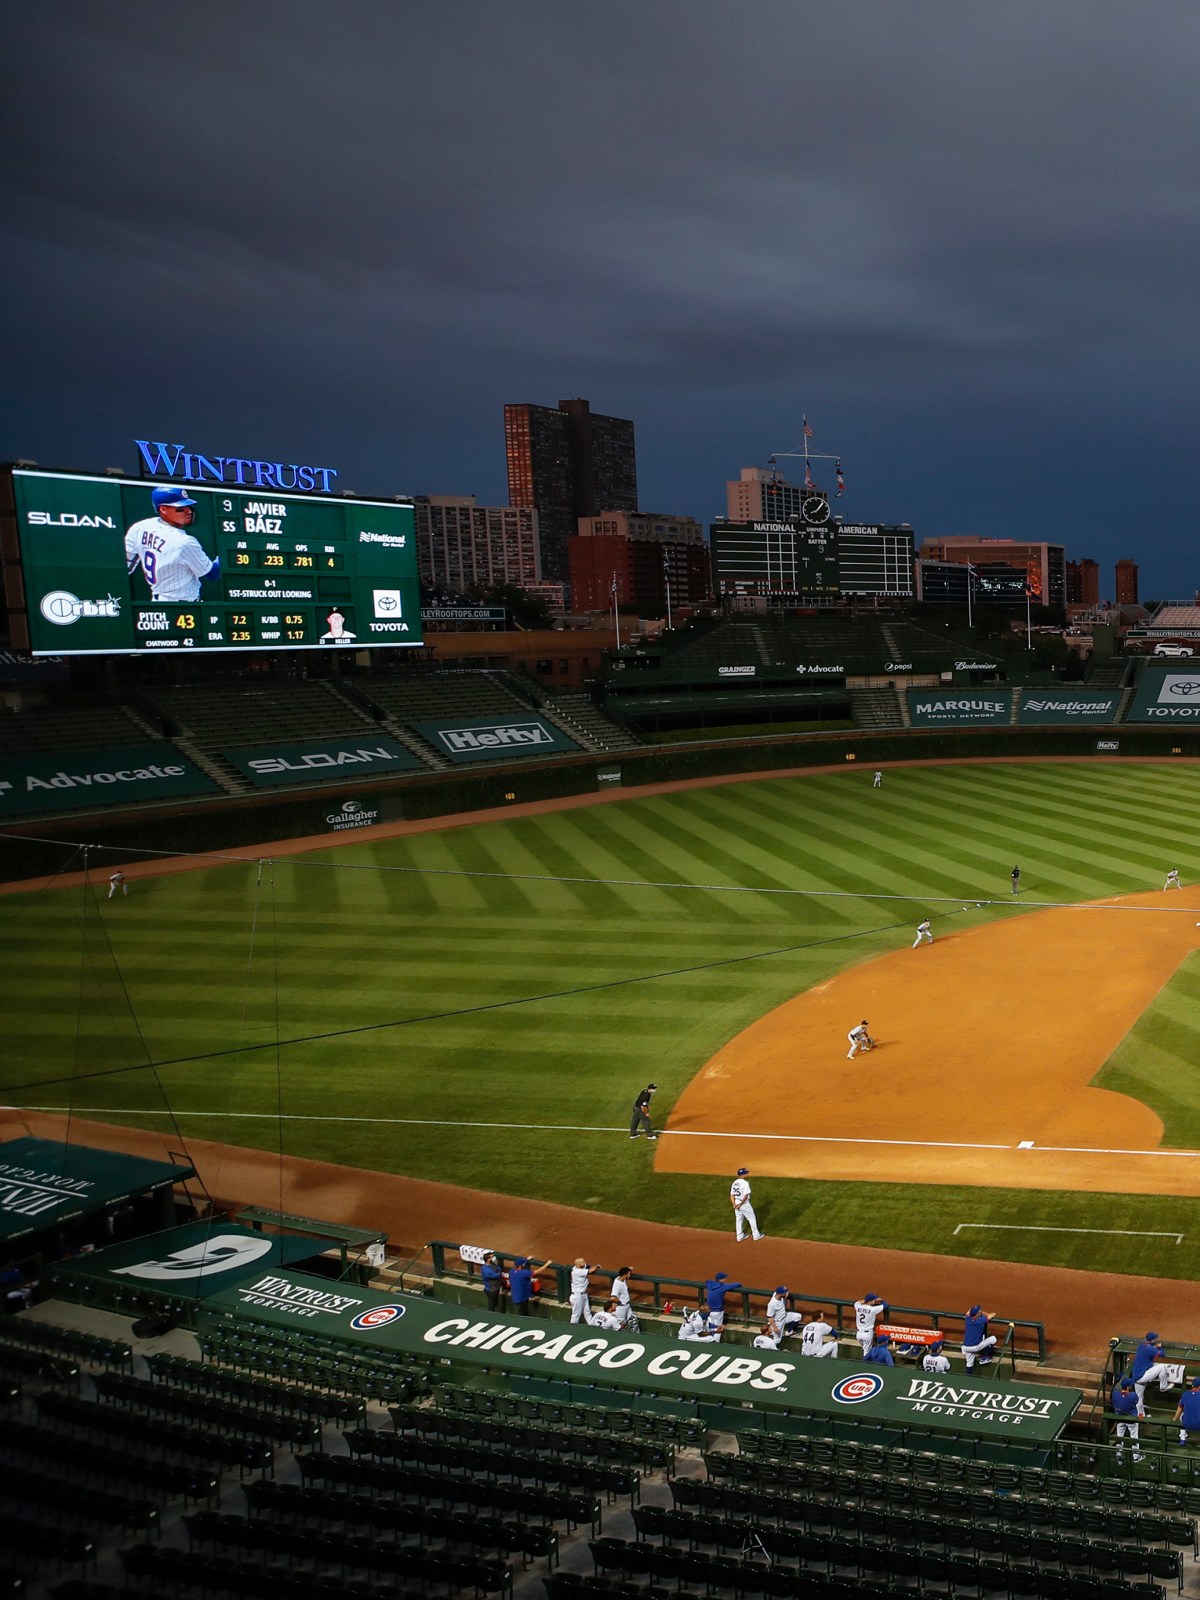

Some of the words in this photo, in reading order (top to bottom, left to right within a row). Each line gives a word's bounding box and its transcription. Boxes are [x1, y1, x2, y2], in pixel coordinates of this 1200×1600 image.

[134, 440, 338, 492] WINTRUST
[223, 500, 233, 512] 9
[244, 501, 287, 517] JAVIER
[223, 520, 236, 533] SS
[245, 514, 283, 535] BÁEZ
[753, 522, 797, 532] NATIONAL
[838, 526, 878, 535] AMERICAN
[237, 541, 248, 549] AB
[265, 542, 280, 551] AVG
[236, 554, 250, 565] 30
[264, 555, 284, 566] .233
[294, 556, 313, 567] .781
[327, 558, 334, 568] 4
[144, 550, 157, 586] 9
[264, 579, 276, 588] 0-1
[816, 577, 822, 585] 2
[229, 589, 267, 598] 1ST-STRUCK
[267, 590, 282, 598] OUT
[282, 590, 312, 599] LOOKING
[40, 590, 122, 626] Orbit
[137, 621, 170, 631] COUNT
[176, 614, 196, 629] 43
[139, 612, 167, 622] PITCH
[210, 616, 219, 624] IP
[232, 615, 247, 625] 7.2
[261, 616, 279, 624] K/BB
[285, 615, 303, 624] 0.75
[369, 623, 409, 632] TOYOTA
[208, 632, 223, 641] ERA
[231, 631, 250, 641] 2.35
[262, 631, 281, 640] WHIP
[286, 630, 304, 640] 1.17
[182, 638, 194, 646] 42
[718, 665, 756, 674] GRAINGER
[807, 663, 844, 674] Advocate
[893, 662, 913, 671] pepsi
[954, 661, 998, 671] Budweiser
[916, 699, 1005, 715] MARQUEE
[450, 728, 542, 749] Hefty
[26, 765, 185, 792] Advocate
[326, 808, 378, 824] Gallagher
[333, 819, 373, 830] INSURANCE
[249, 1275, 364, 1311] WINTRUST
[240, 1294, 320, 1318] MORTGAGE
[859, 1313, 866, 1324] 2
[803, 1332, 815, 1344] 44
[889, 1333, 926, 1343] GATORADE
[423, 1317, 646, 1370] CHICAGO
[646, 1349, 797, 1391] CUBS
[907, 1378, 1061, 1415] WINTRUST
[911, 1402, 1025, 1425] MORTGAGE
